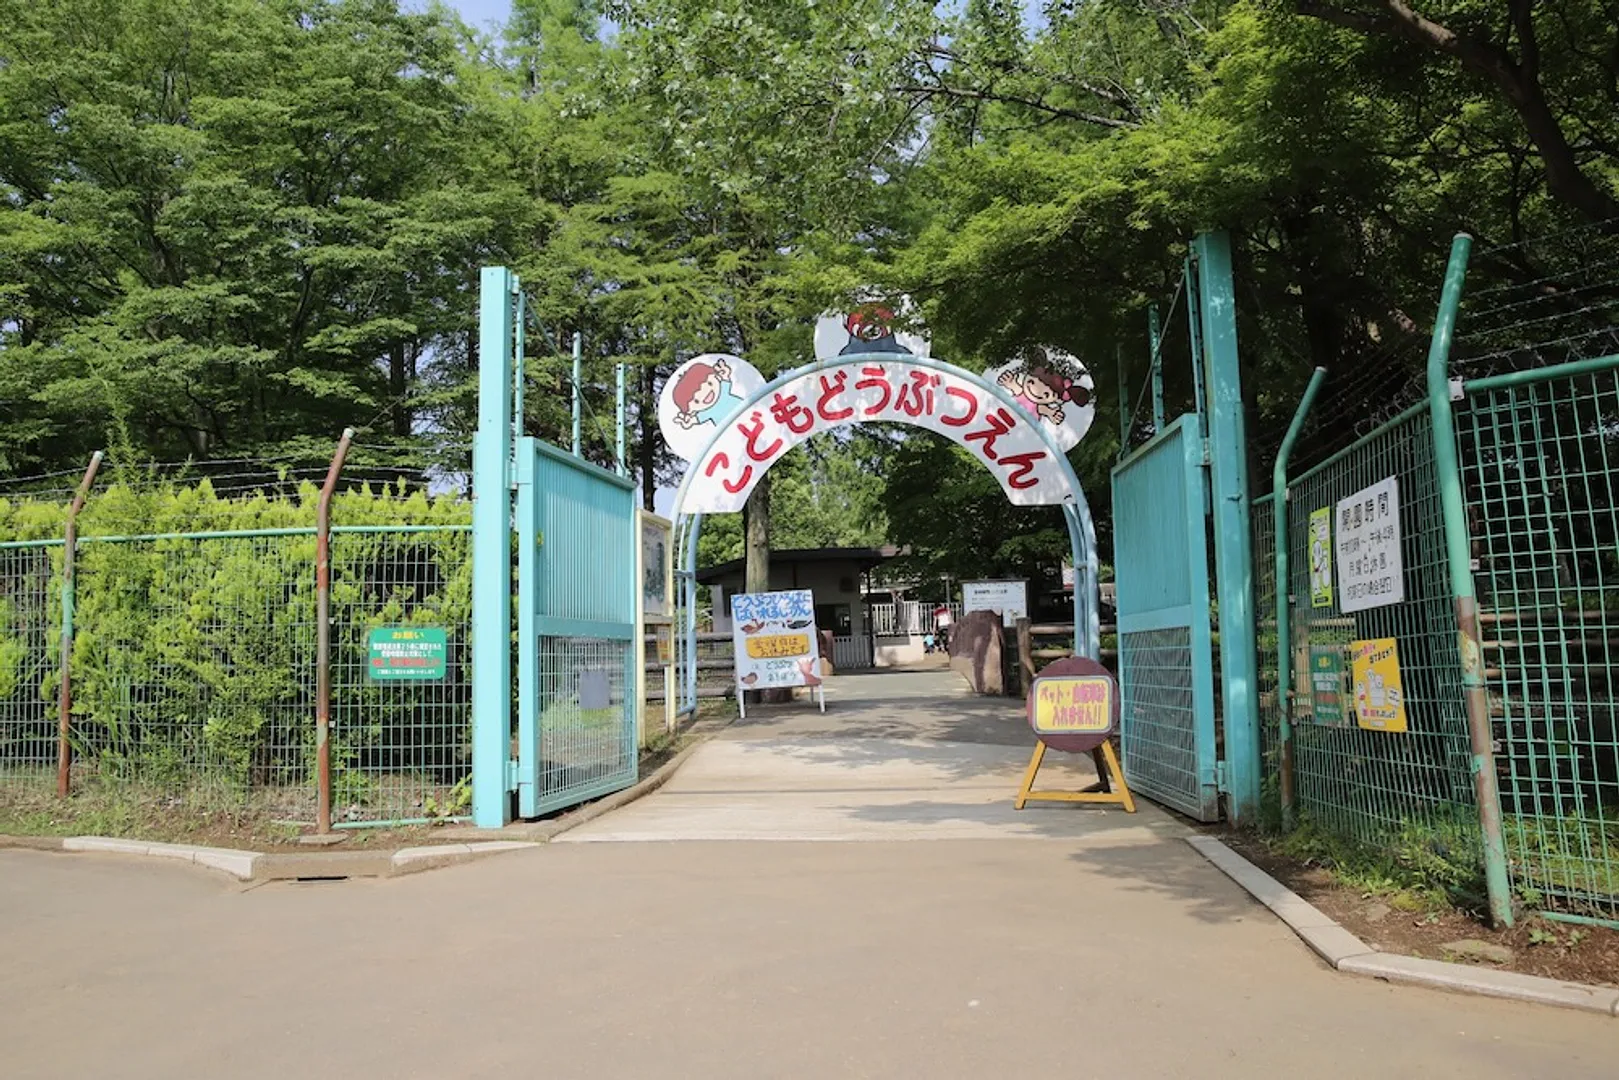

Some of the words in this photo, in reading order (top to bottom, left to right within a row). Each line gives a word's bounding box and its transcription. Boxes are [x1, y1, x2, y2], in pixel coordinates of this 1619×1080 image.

[706, 367, 1046, 494] こどもどうぶつえん
